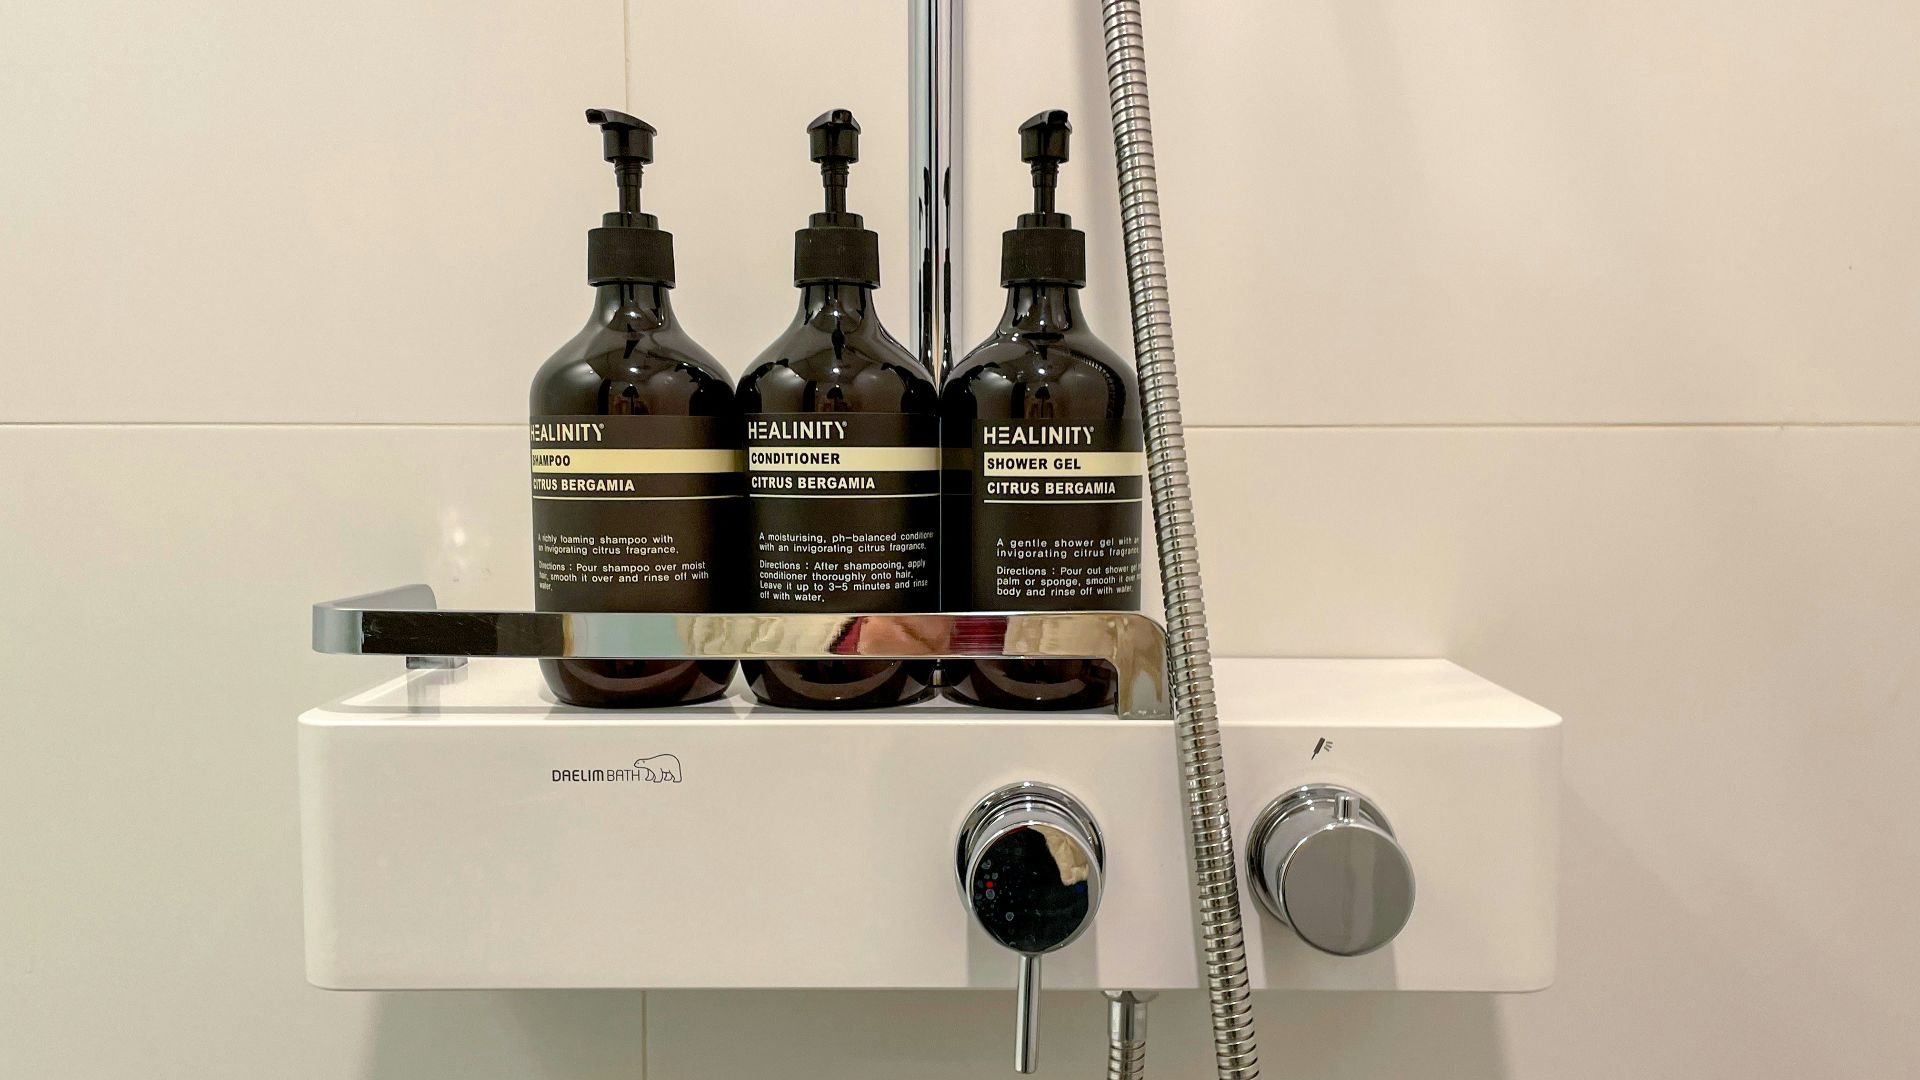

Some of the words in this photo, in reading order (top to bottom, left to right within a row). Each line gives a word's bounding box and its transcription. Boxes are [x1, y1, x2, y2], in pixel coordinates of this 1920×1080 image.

[748, 421, 844, 439] HEALINITY
[984, 426, 1091, 445] HEALINITY
[533, 454, 570, 466] SHAMPOO
[751, 453, 840, 465] CONDITIONER
[987, 458, 1048, 470] SHOWER
[1054, 458, 1081, 470] GEL
[533, 478, 557, 491] CITRUS
[561, 479, 635, 491] BERGAMIA
[751, 476, 793, 489] CITRUS
[797, 477, 876, 490] BERGAMIA
[987, 482, 1040, 494] CITRUS
[1045, 482, 1116, 495] BERGAMIA
[560, 534, 595, 545] foaming
[600, 534, 648, 544] shampoo
[652, 535, 673, 543] with
[759, 532, 765, 541] A
[832, 532, 897, 543] ph-balanced
[900, 531, 934, 540] conditioner
[997, 538, 1004, 547] A
[1010, 538, 1048, 549] gentle
[1054, 538, 1094, 548] shower
[1100, 537, 1114, 548] gel
[1119, 536, 1132, 545] with
[544, 544, 588, 556] invigorating
[592, 546, 621, 555] citrus
[625, 545, 679, 555] fragrance.
[759, 543, 775, 551] with
[793, 544, 853, 554] invigorating
[858, 544, 886, 552] citrus
[997, 548, 1067, 559] invigorating
[1073, 548, 1104, 557] citrus
[576, 563, 597, 572] Pour
[602, 563, 650, 573] shampoo
[655, 563, 677, 572] over
[682, 561, 705, 570] moist
[759, 560, 801, 570] Directions
[814, 561, 839, 571] After
[907, 558, 926, 570] apply
[997, 566, 1046, 575] Directions
[1061, 567, 1082, 575] Pour
[1087, 566, 1101, 575] out
[1105, 565, 1129, 574] shower
[550, 573, 577, 582] smooth
[581, 573, 588, 582] it
[592, 574, 613, 583] over
[619, 573, 638, 582] and
[644, 573, 669, 582] rinse
[674, 573, 687, 581] off
[692, 571, 709, 579] with
[759, 571, 807, 581] conditioner
[812, 571, 867, 583] thoroughly
[871, 572, 892, 580] onto
[997, 577, 1020, 587] palm
[1086, 576, 1116, 585] smooth
[1118, 575, 1123, 583] it
[759, 581, 782, 590] Leave
[786, 582, 792, 590] it
[796, 584, 809, 592] up
[814, 582, 824, 591] to
[828, 583, 848, 592] 3-5
[853, 582, 891, 591] minutes
[895, 580, 910, 589] and
[913, 578, 928, 588] rinse
[759, 591, 770, 600] off
[773, 592, 790, 601] with
[997, 587, 1021, 598] body
[1026, 587, 1046, 596] and
[1051, 587, 1075, 596] rinse
[1080, 587, 1092, 596] off
[1097, 586, 1113, 595] with
[552, 769, 604, 782] DAELIM
[606, 769, 640, 782] BATH
